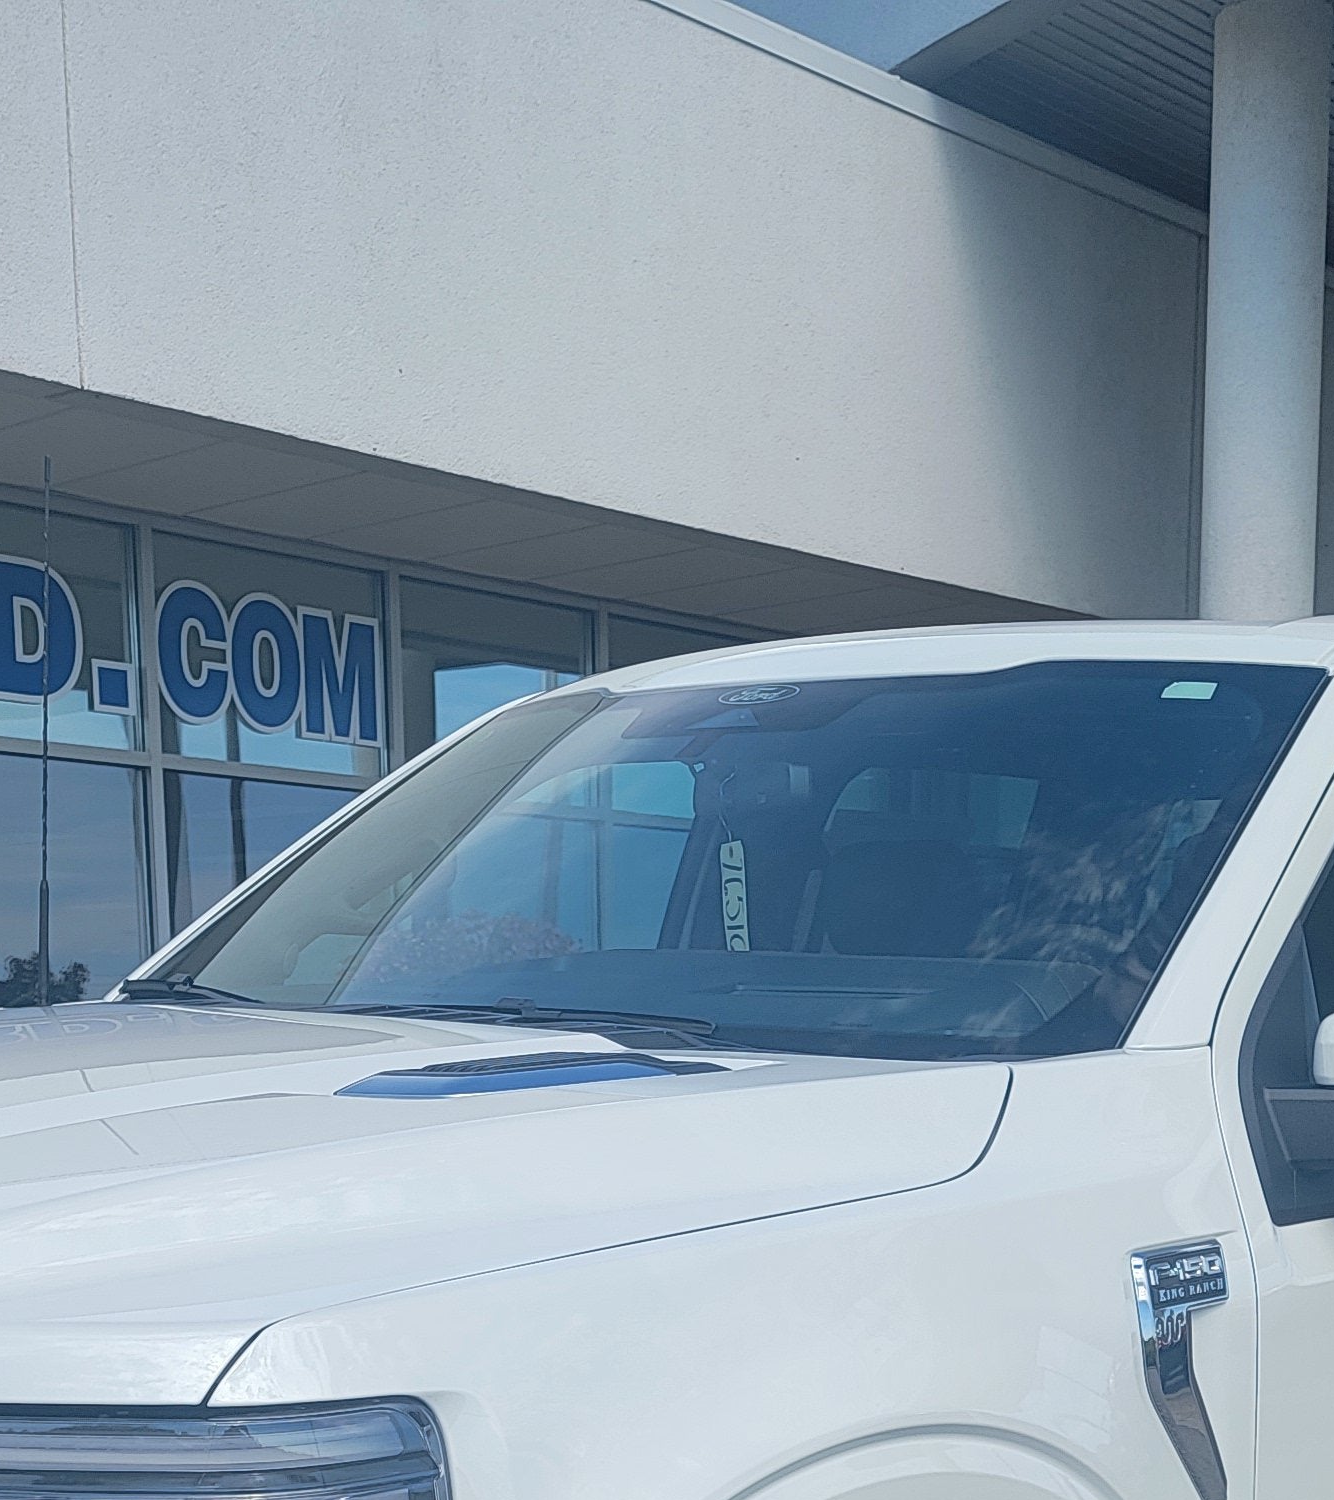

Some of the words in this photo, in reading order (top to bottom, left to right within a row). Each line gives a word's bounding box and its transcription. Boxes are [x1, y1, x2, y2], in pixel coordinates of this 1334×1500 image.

[1149, 1254, 1223, 1286] F-150
[1158, 1287, 1186, 1302] KING
[1188, 1278, 1224, 1296] RANCH
